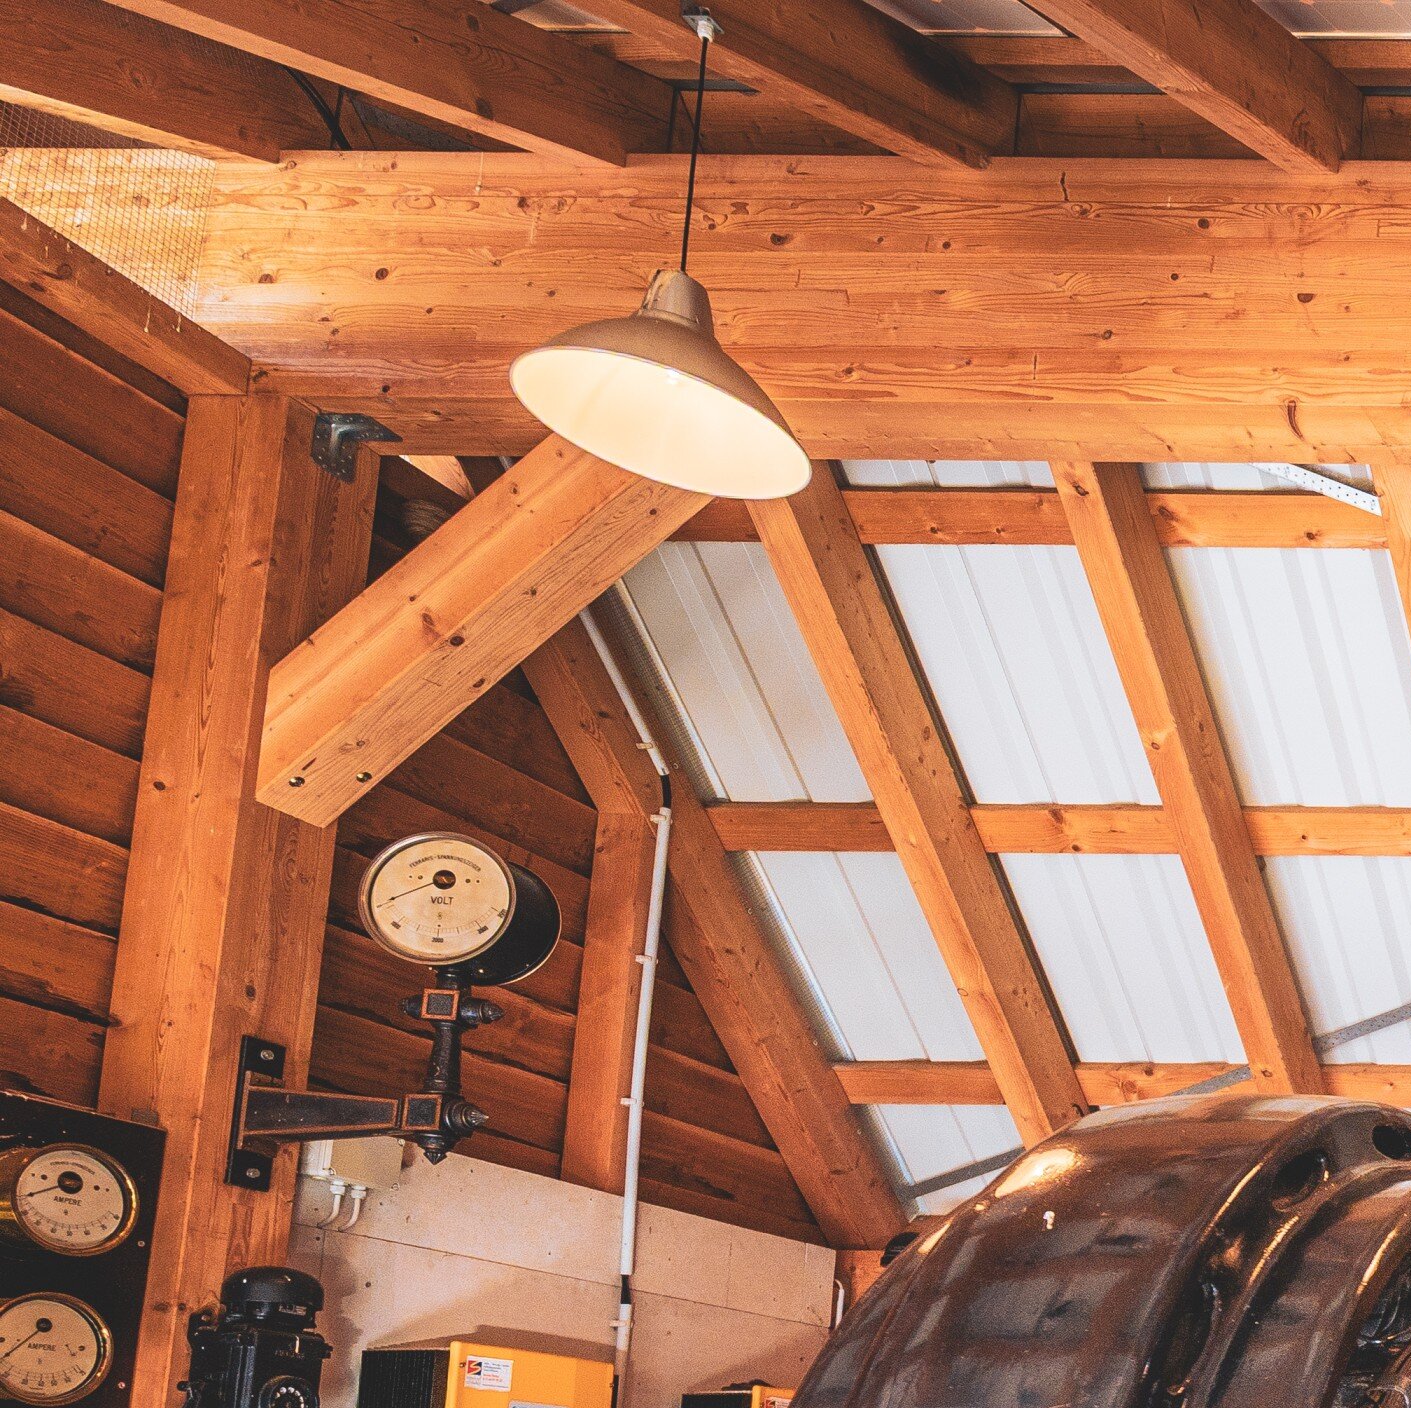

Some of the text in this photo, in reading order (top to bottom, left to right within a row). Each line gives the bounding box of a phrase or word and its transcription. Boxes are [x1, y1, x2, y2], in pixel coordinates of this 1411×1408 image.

[431, 896, 454, 905] VOLT
[53, 1196, 82, 1206] AMPERE
[28, 1343, 57, 1352] AMPERE
